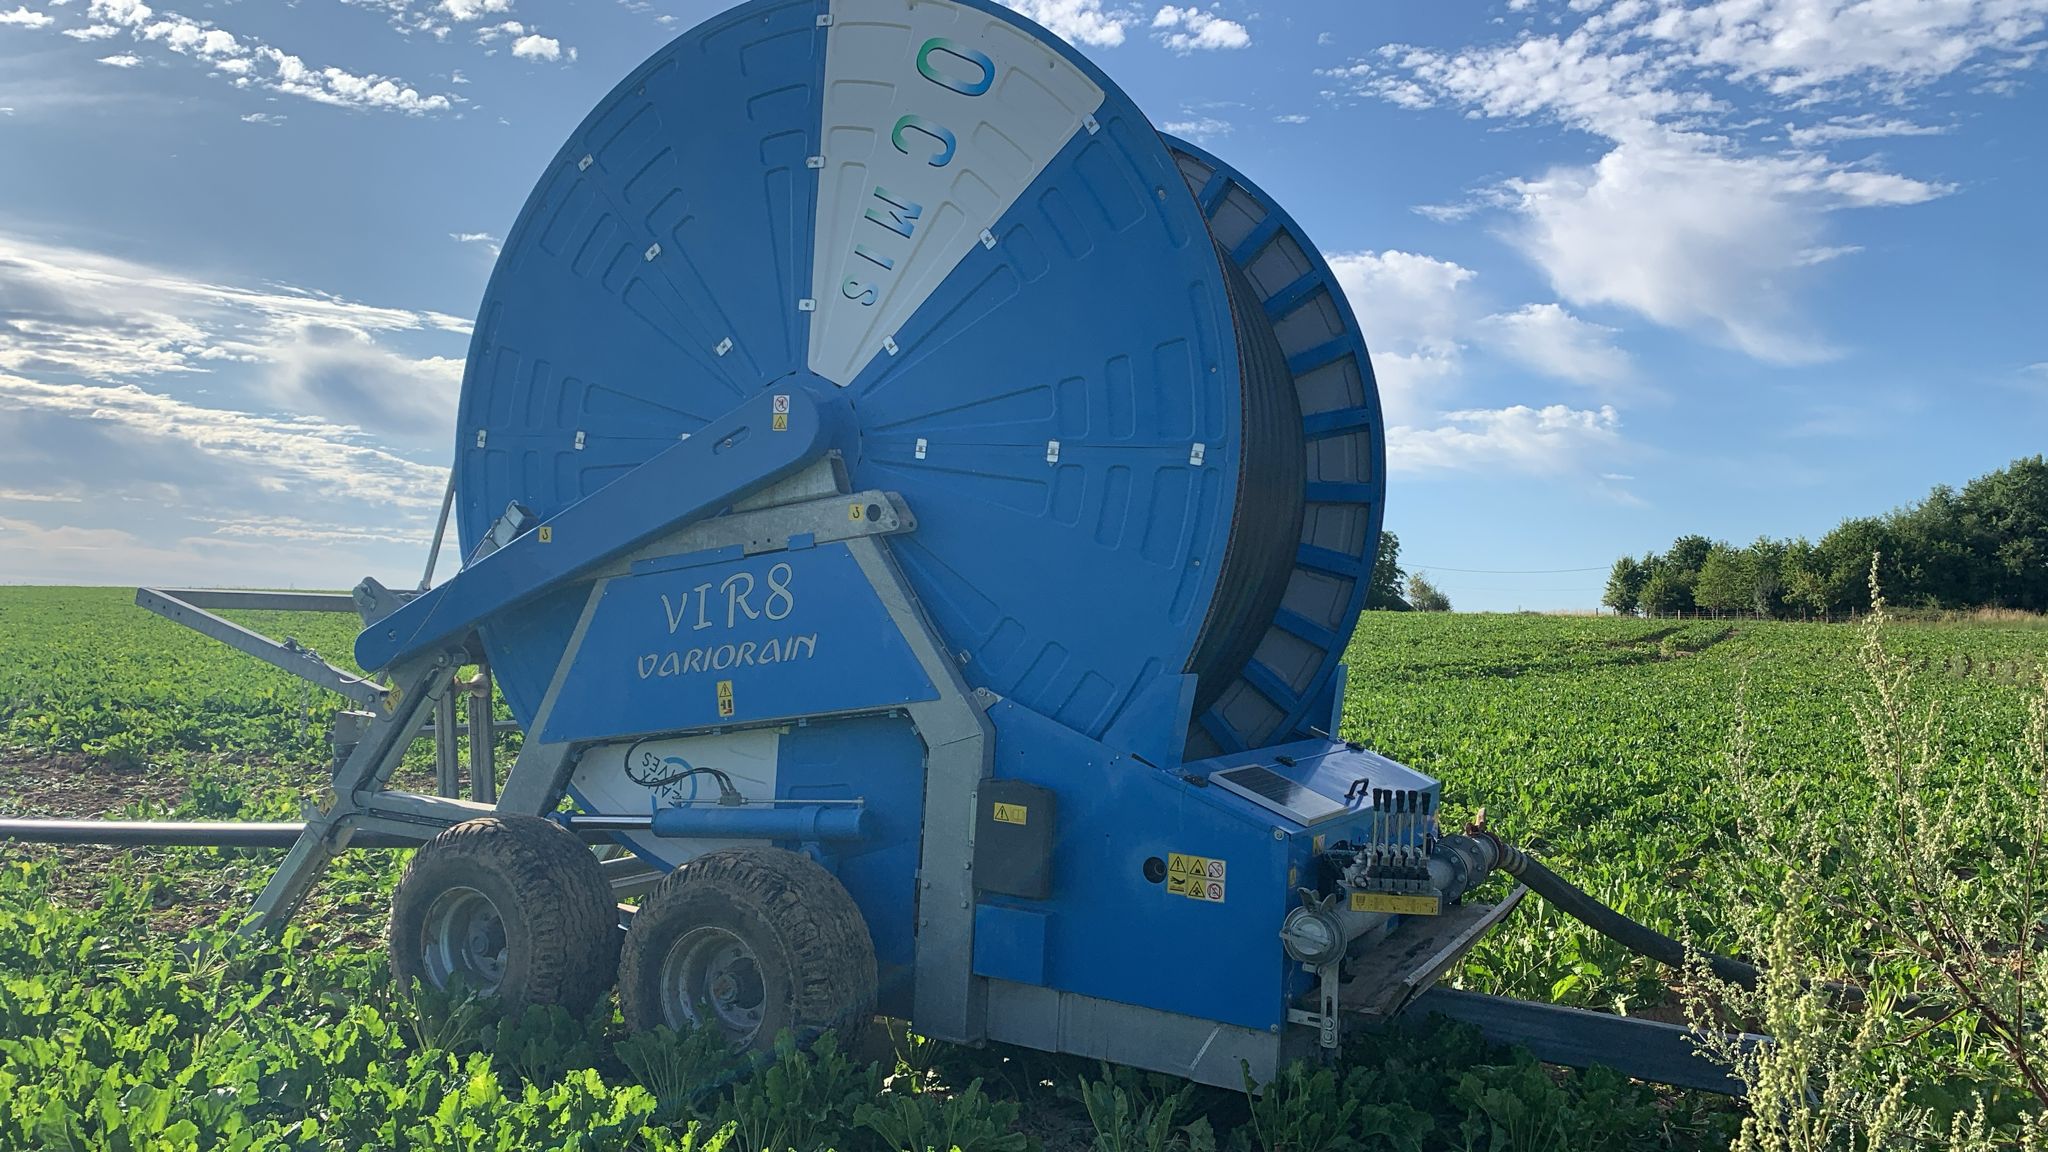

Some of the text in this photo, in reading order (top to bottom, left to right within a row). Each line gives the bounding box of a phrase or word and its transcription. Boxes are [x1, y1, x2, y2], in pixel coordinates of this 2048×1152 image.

[842, 37, 995, 306] OCMIS
[661, 563, 794, 634] VIR8
[638, 633, 818, 679] VARIORAIN
